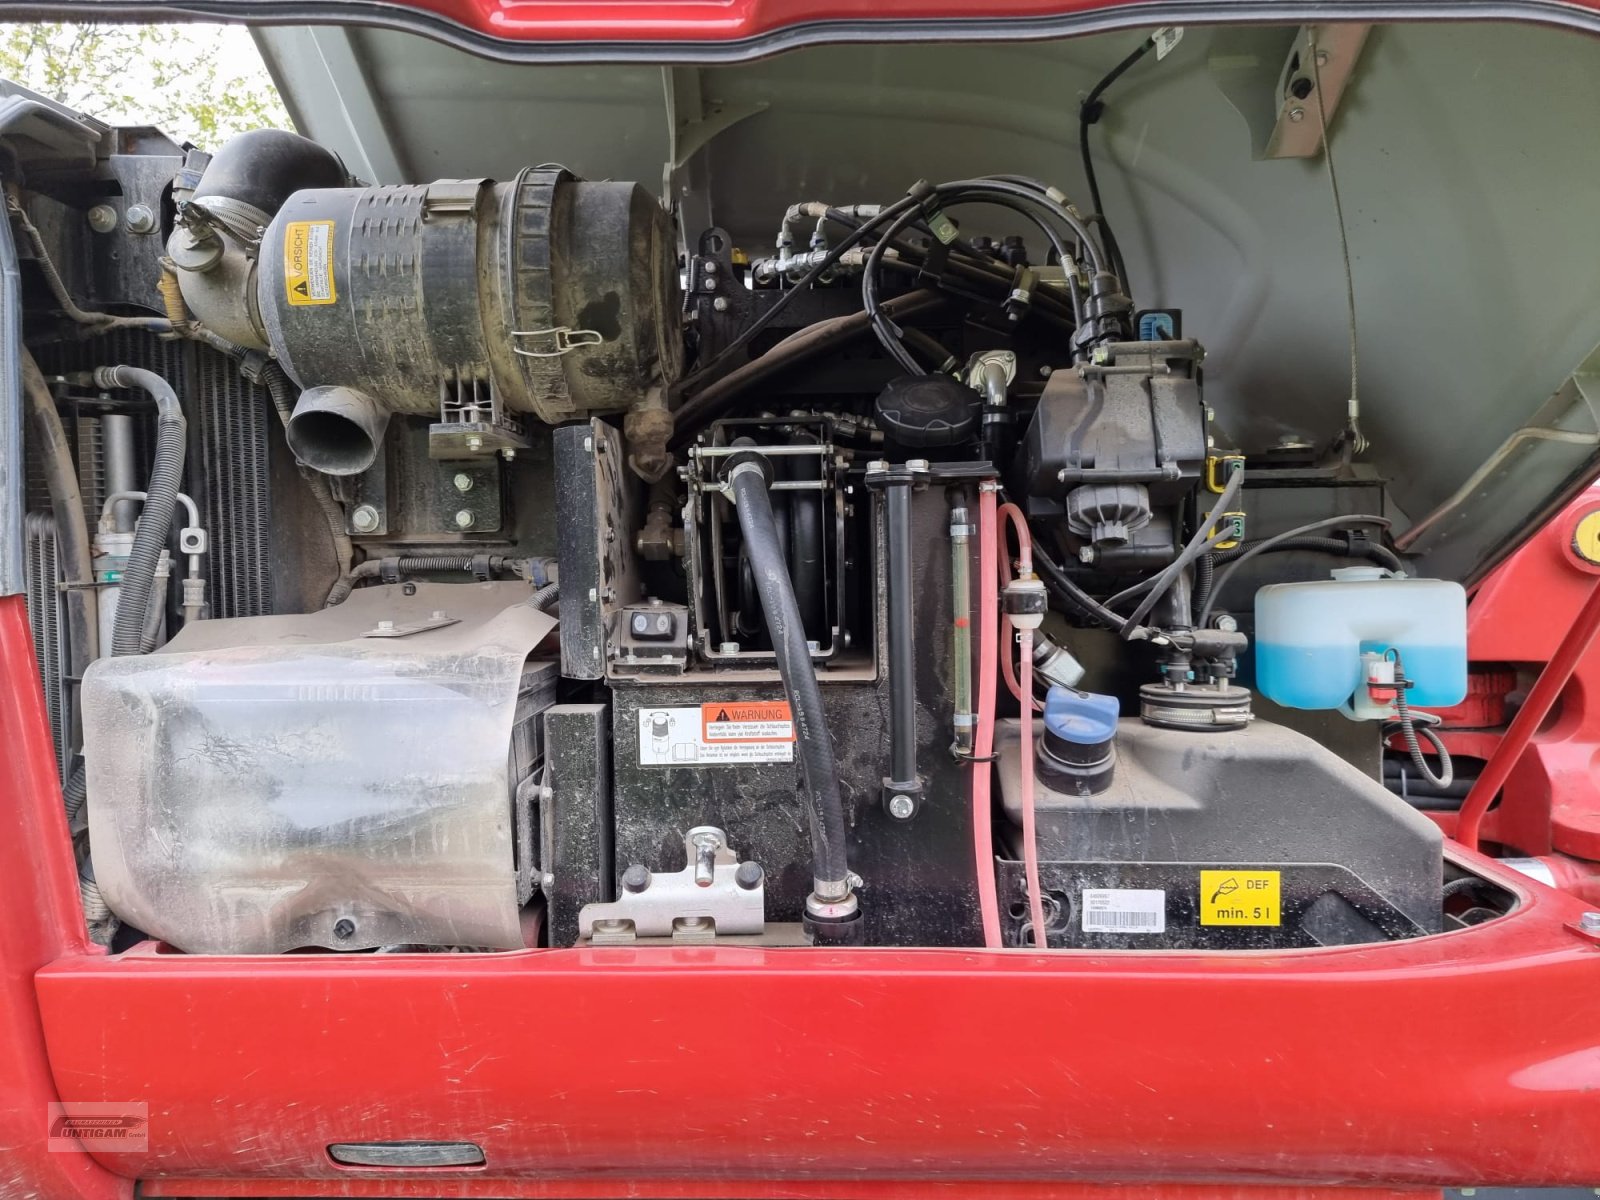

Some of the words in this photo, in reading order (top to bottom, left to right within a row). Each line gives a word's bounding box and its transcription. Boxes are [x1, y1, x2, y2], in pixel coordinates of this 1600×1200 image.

[293, 229, 305, 277] VORSICHT
[731, 709, 783, 720] WARNUNG
[1246, 879, 1270, 890] DEF
[1217, 907, 1248, 919] min.
[1253, 907, 1261, 919] 5
